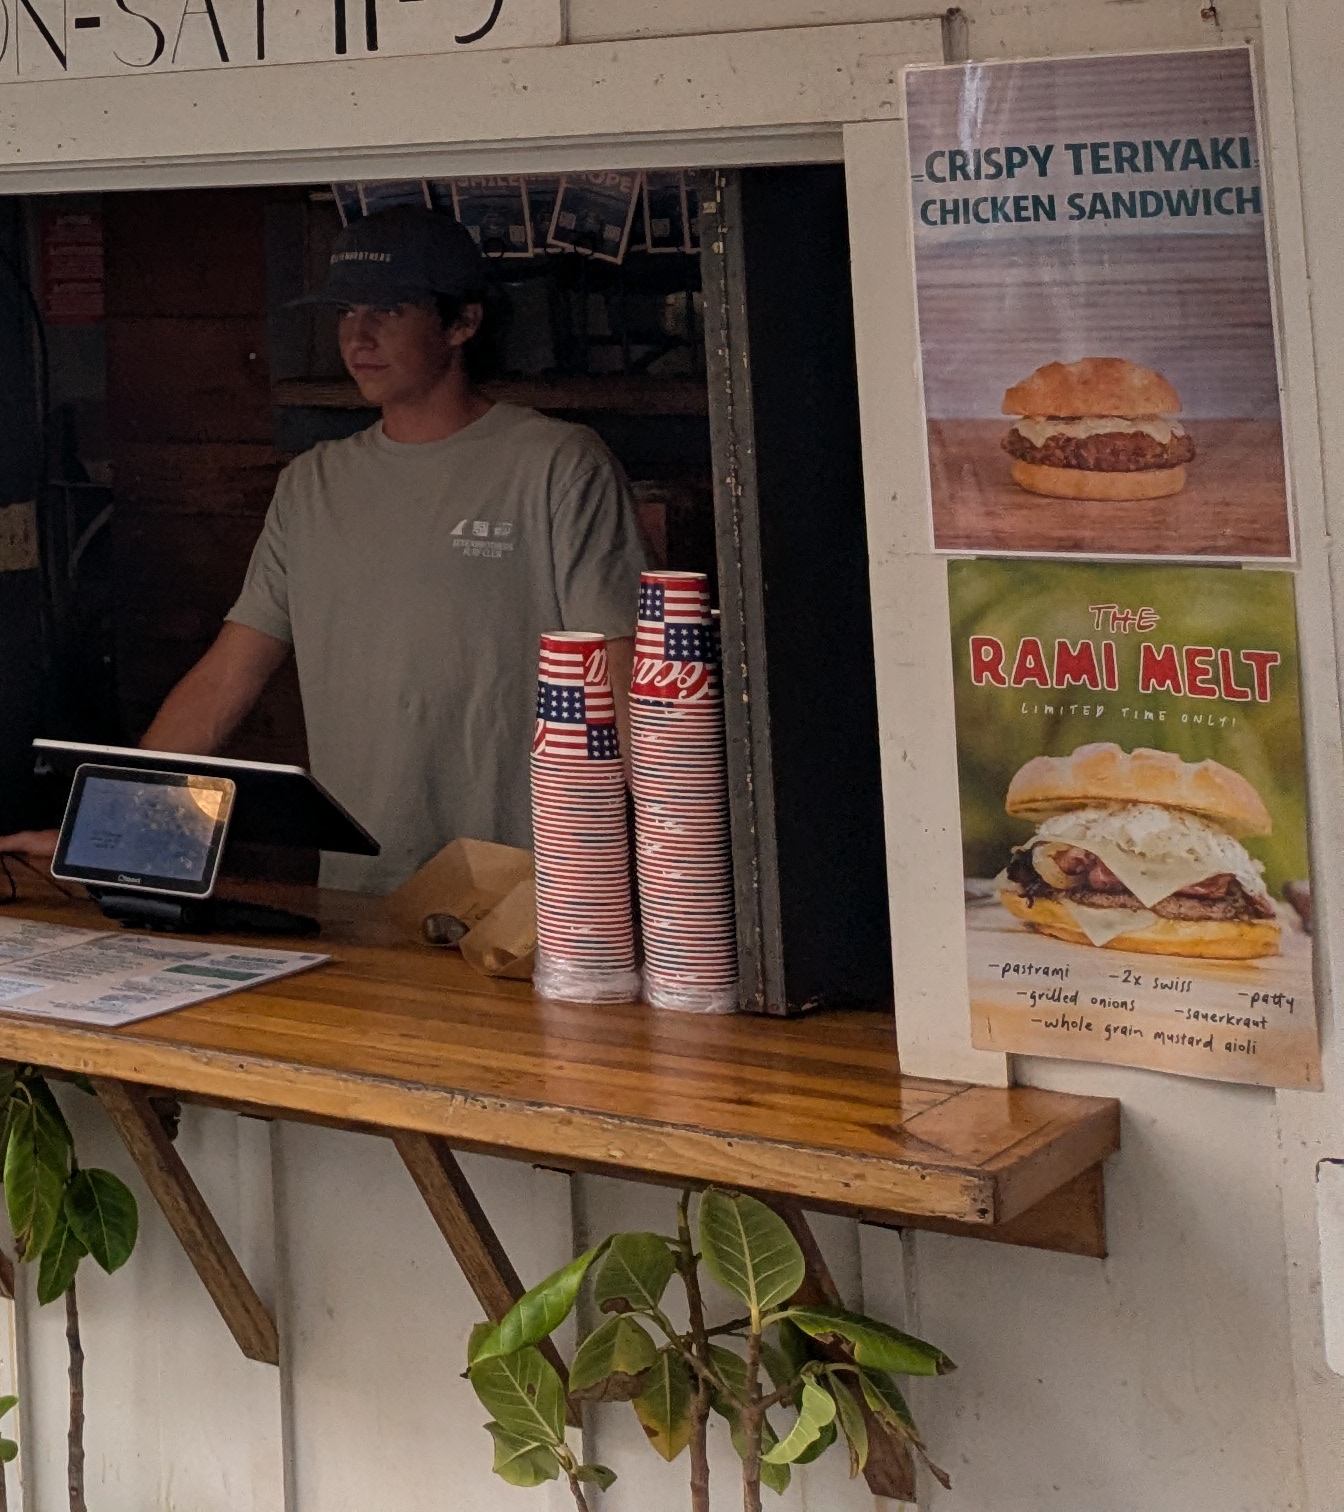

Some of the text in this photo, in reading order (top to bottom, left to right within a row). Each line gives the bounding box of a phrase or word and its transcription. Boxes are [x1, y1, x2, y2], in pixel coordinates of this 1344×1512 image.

[924, 137, 1251, 183] CRISPY TERIYAKI
[920, 186, 1261, 226] CHICKEN SANDWICH
[1089, 604, 1161, 634] THE
[969, 635, 1281, 703] RAMI MELT
[1021, 702, 1238, 728] LIMITED TIME ONLY!
[1153, 976, 1193, 993] swiss
[1090, 996, 1136, 1012] onions
[1104, 1020, 1144, 1041] grain
[1153, 1029, 1215, 1053] mustard
[1224, 1038, 1258, 1056] aioli
